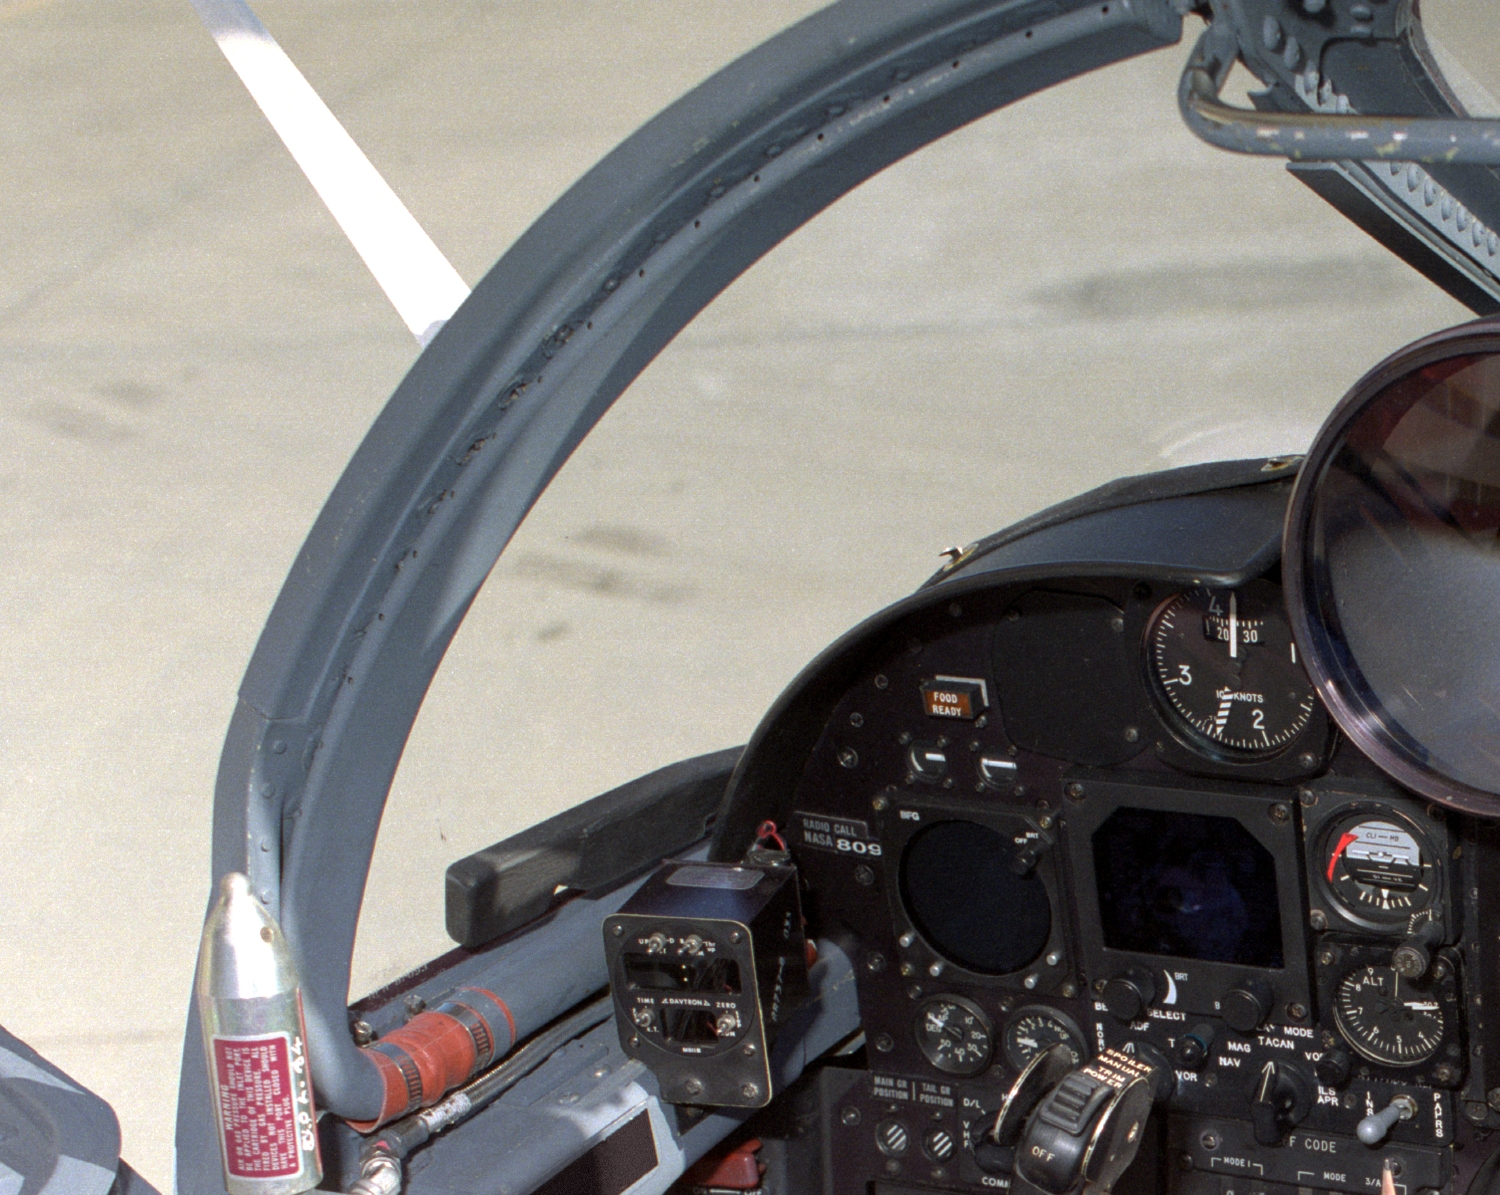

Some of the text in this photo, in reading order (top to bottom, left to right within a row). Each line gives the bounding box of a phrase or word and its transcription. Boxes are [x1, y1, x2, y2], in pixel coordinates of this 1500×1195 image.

[933, 692, 958, 703] FOOD
[932, 705, 962, 716] READY
[803, 819, 857, 836] RADIO CALL
[804, 831, 882, 856] NASA 809
[1147, 1009, 1187, 1021] SELECT
[1284, 1026, 1314, 1038] MODE
[1228, 1041, 1251, 1053] MAG
[1257, 1036, 1295, 1050] TACAN
[225, 1046, 233, 1060] NOT
[1106, 1048, 1152, 1072] SPOILER
[1097, 1055, 1141, 1077] MANUAL
[1219, 1056, 1241, 1068] NAV
[228, 1064, 236, 1089] SHOULD
[1083, 1067, 1122, 1089] POWER
[1098, 1066, 1126, 1083] TRIM
[1175, 1070, 1198, 1082] VOR
[1318, 1086, 1336, 1096] ILS
[221, 1084, 234, 1130] WARNING
[1317, 1095, 1339, 1106] APR
[232, 1093, 240, 1127] PRESSURE
[260, 1046, 280, 1170] DEVICES NOT INSTALLED SHOULD
[236, 1147, 244, 1156] OR
[1304, 1138, 1336, 1153] CODE
[1032, 1145, 1055, 1162] OFF
